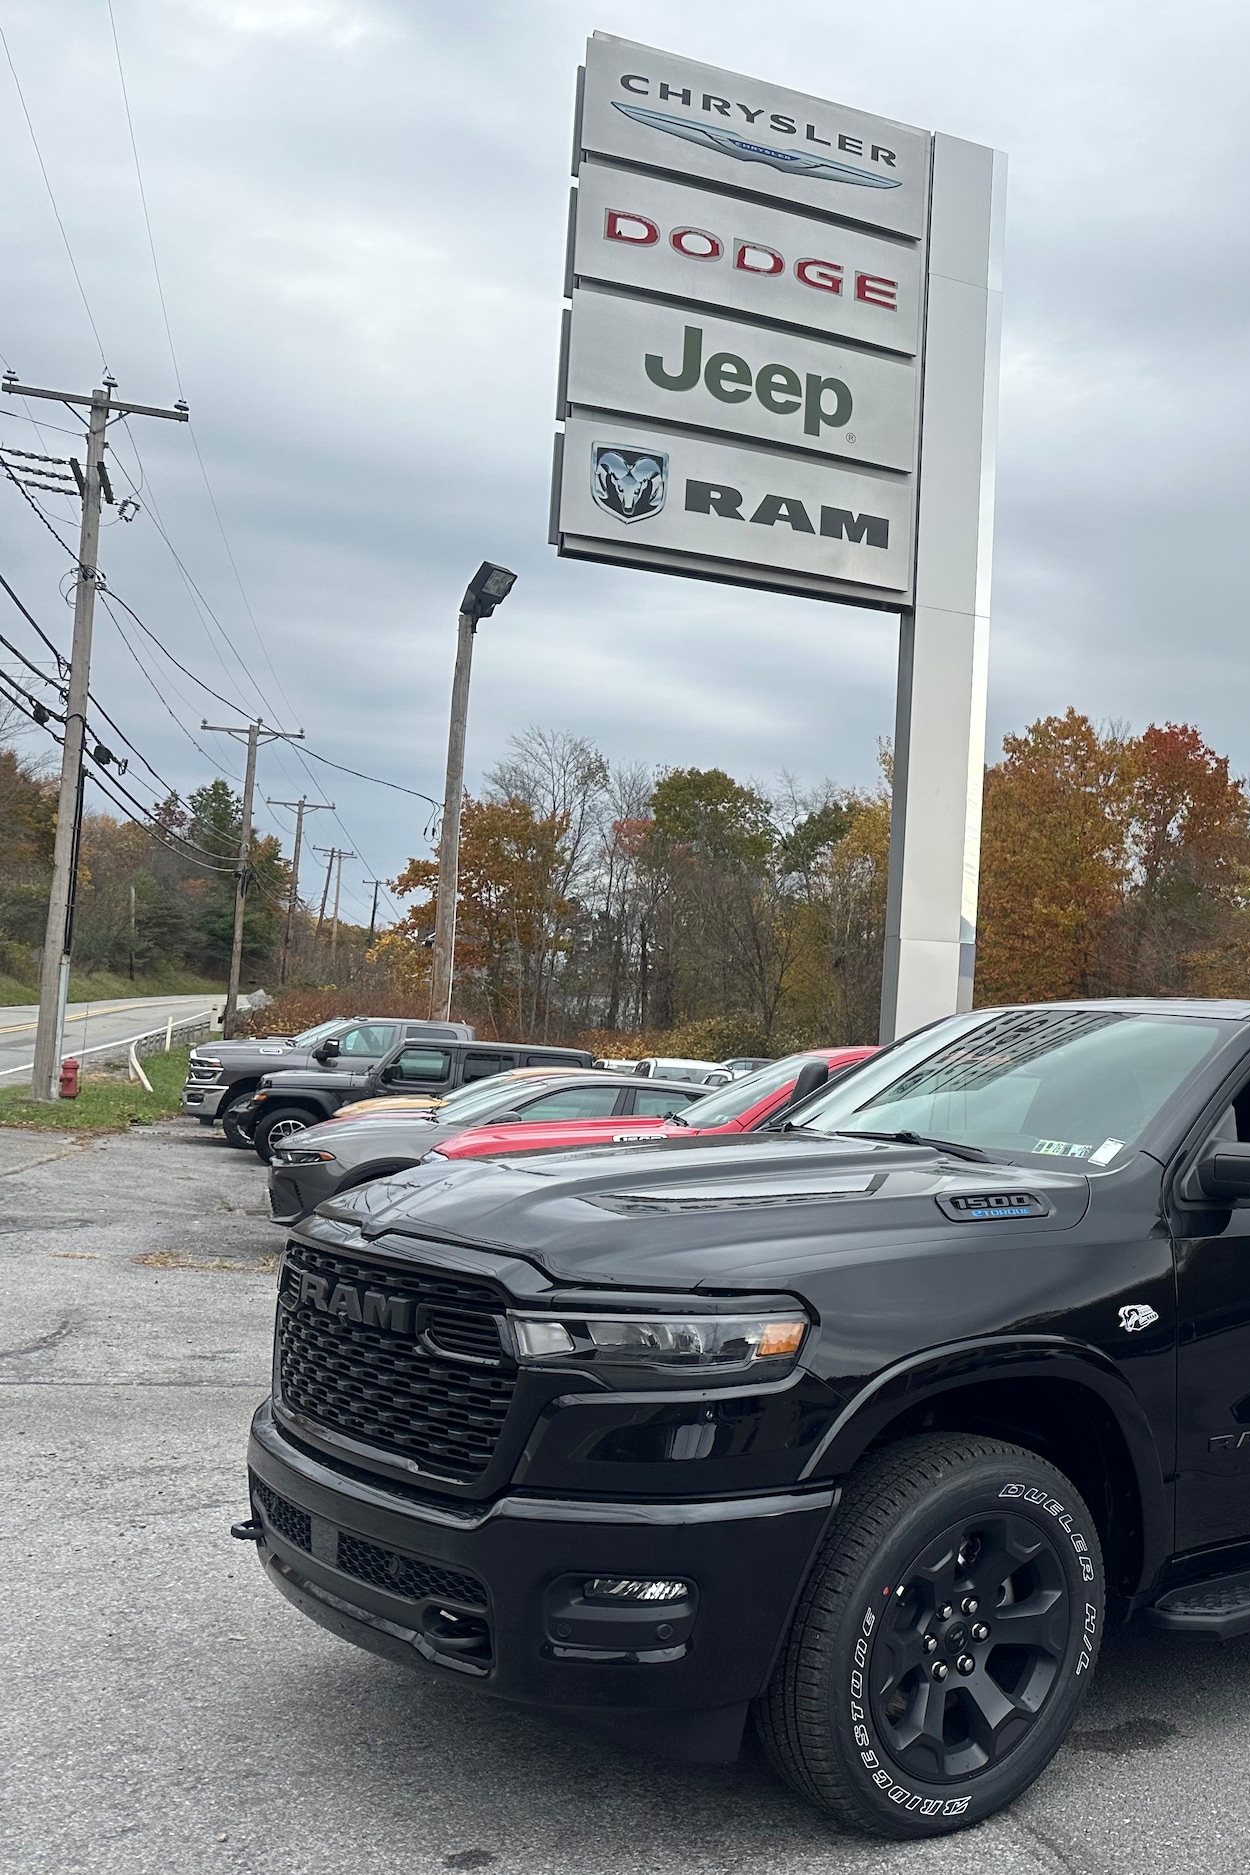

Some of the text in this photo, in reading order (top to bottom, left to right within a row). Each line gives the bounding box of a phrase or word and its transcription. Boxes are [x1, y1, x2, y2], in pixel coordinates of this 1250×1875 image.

[620, 74, 898, 167] CHRYSLER
[734, 141, 791, 160] CHRYSLER
[603, 207, 898, 312] DODGE
[644, 325, 854, 437] Jeep
[684, 479, 889, 549] RAM
[952, 1195, 1031, 1209] 1500
[300, 1272, 413, 1334] RAM
[998, 1483, 1097, 1676] DUELER H/L
[850, 1606, 973, 1816] BRIDGESTONE
